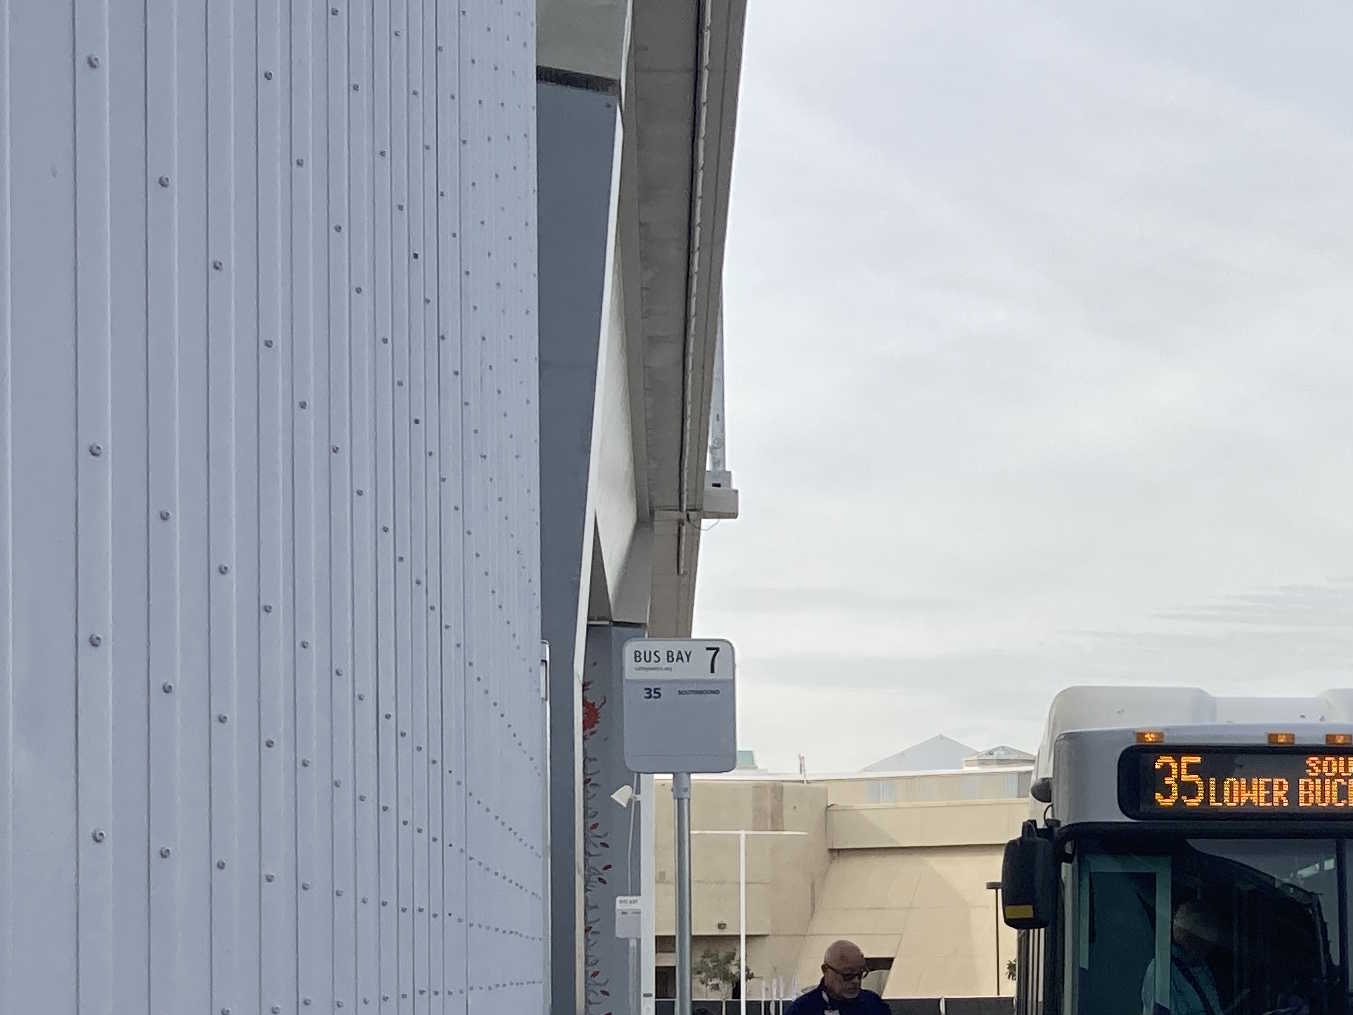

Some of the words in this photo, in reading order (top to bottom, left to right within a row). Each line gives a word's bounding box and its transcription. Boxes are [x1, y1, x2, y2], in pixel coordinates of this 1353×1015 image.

[633, 650, 661, 663] BUS
[666, 650, 692, 663] BAY
[705, 647, 720, 673] 7
[644, 687, 661, 699] 35
[1155, 756, 1204, 806] 35
[1210, 778, 1289, 806] LOWER
